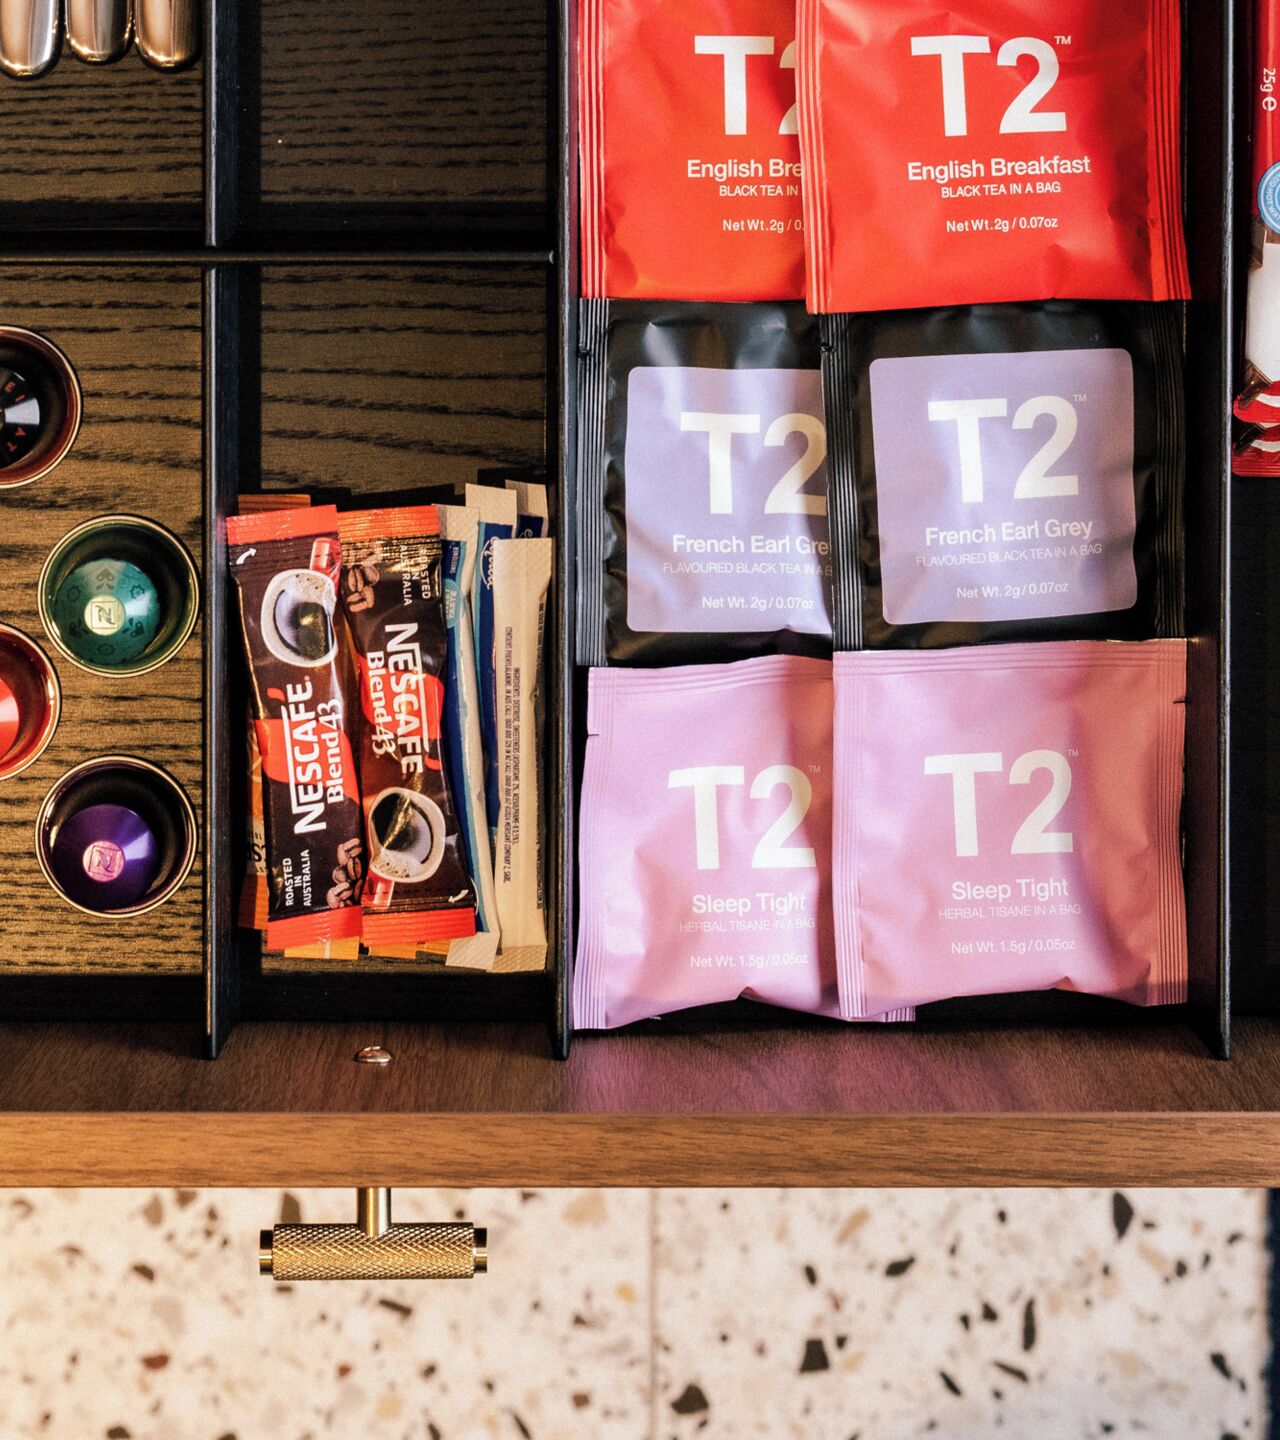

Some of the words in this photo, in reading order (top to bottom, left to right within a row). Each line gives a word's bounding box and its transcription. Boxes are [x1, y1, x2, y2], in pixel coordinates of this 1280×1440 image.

[910, 35, 1067, 137] T2
[1260, 68, 1276, 93] 25g
[687, 159, 763, 182] English
[907, 160, 984, 184] English
[991, 156, 1091, 177] Breakfast
[719, 185, 758, 197] BLACK
[760, 185, 784, 197] TEA
[786, 185, 799, 196] IN
[941, 185, 981, 198] BLACK
[983, 184, 1007, 197] TEA
[1010, 183, 1022, 195] IN
[1025, 183, 1034, 194] A
[1036, 181, 1061, 194] BAG
[722, 219, 745, 231] Net
[946, 220, 969, 233] Net
[1019, 216, 1058, 229] 0.07oz
[927, 395, 1080, 503] T2
[680, 411, 828, 516] T2
[925, 523, 996, 546] French
[1001, 520, 1039, 542] Earl
[1044, 518, 1093, 542] Grey
[672, 535, 745, 554] French
[751, 535, 790, 553] Earl
[916, 552, 986, 567] FLAVOURED
[988, 549, 1028, 563] BLACK
[1030, 548, 1053, 560] TEA
[1055, 547, 1066, 558] IN
[1070, 546, 1079, 557] A
[1080, 543, 1103, 556] BAG
[663, 562, 734, 574] FLAVOURED
[736, 562, 776, 574] BLACK
[779, 563, 802, 575] TEA
[804, 564, 814, 575] IN
[816, 565, 824, 576] A
[702, 597, 725, 609] Net
[956, 586, 979, 599] Net
[924, 749, 1074, 857] T2
[667, 764, 817, 871] T2
[282, 858, 294, 906] ROASTED
[293, 875, 302, 887] IN
[300, 849, 313, 906] AUSTRALIA
[951, 880, 1012, 903] Sleep
[1016, 878, 1069, 901] Tight
[692, 894, 752, 917] Sleep
[756, 892, 807, 916] Tight
[938, 907, 987, 920] HERBAL
[989, 905, 1033, 918] TISANE
[1034, 905, 1045, 916] IN
[1048, 905, 1058, 915] A
[1059, 903, 1081, 915] BAG
[679, 920, 726, 933] HERBAL
[728, 919, 771, 932] TISANE
[796, 917, 816, 929] BAG
[951, 941, 973, 954] Net
[690, 955, 713, 968] Net
